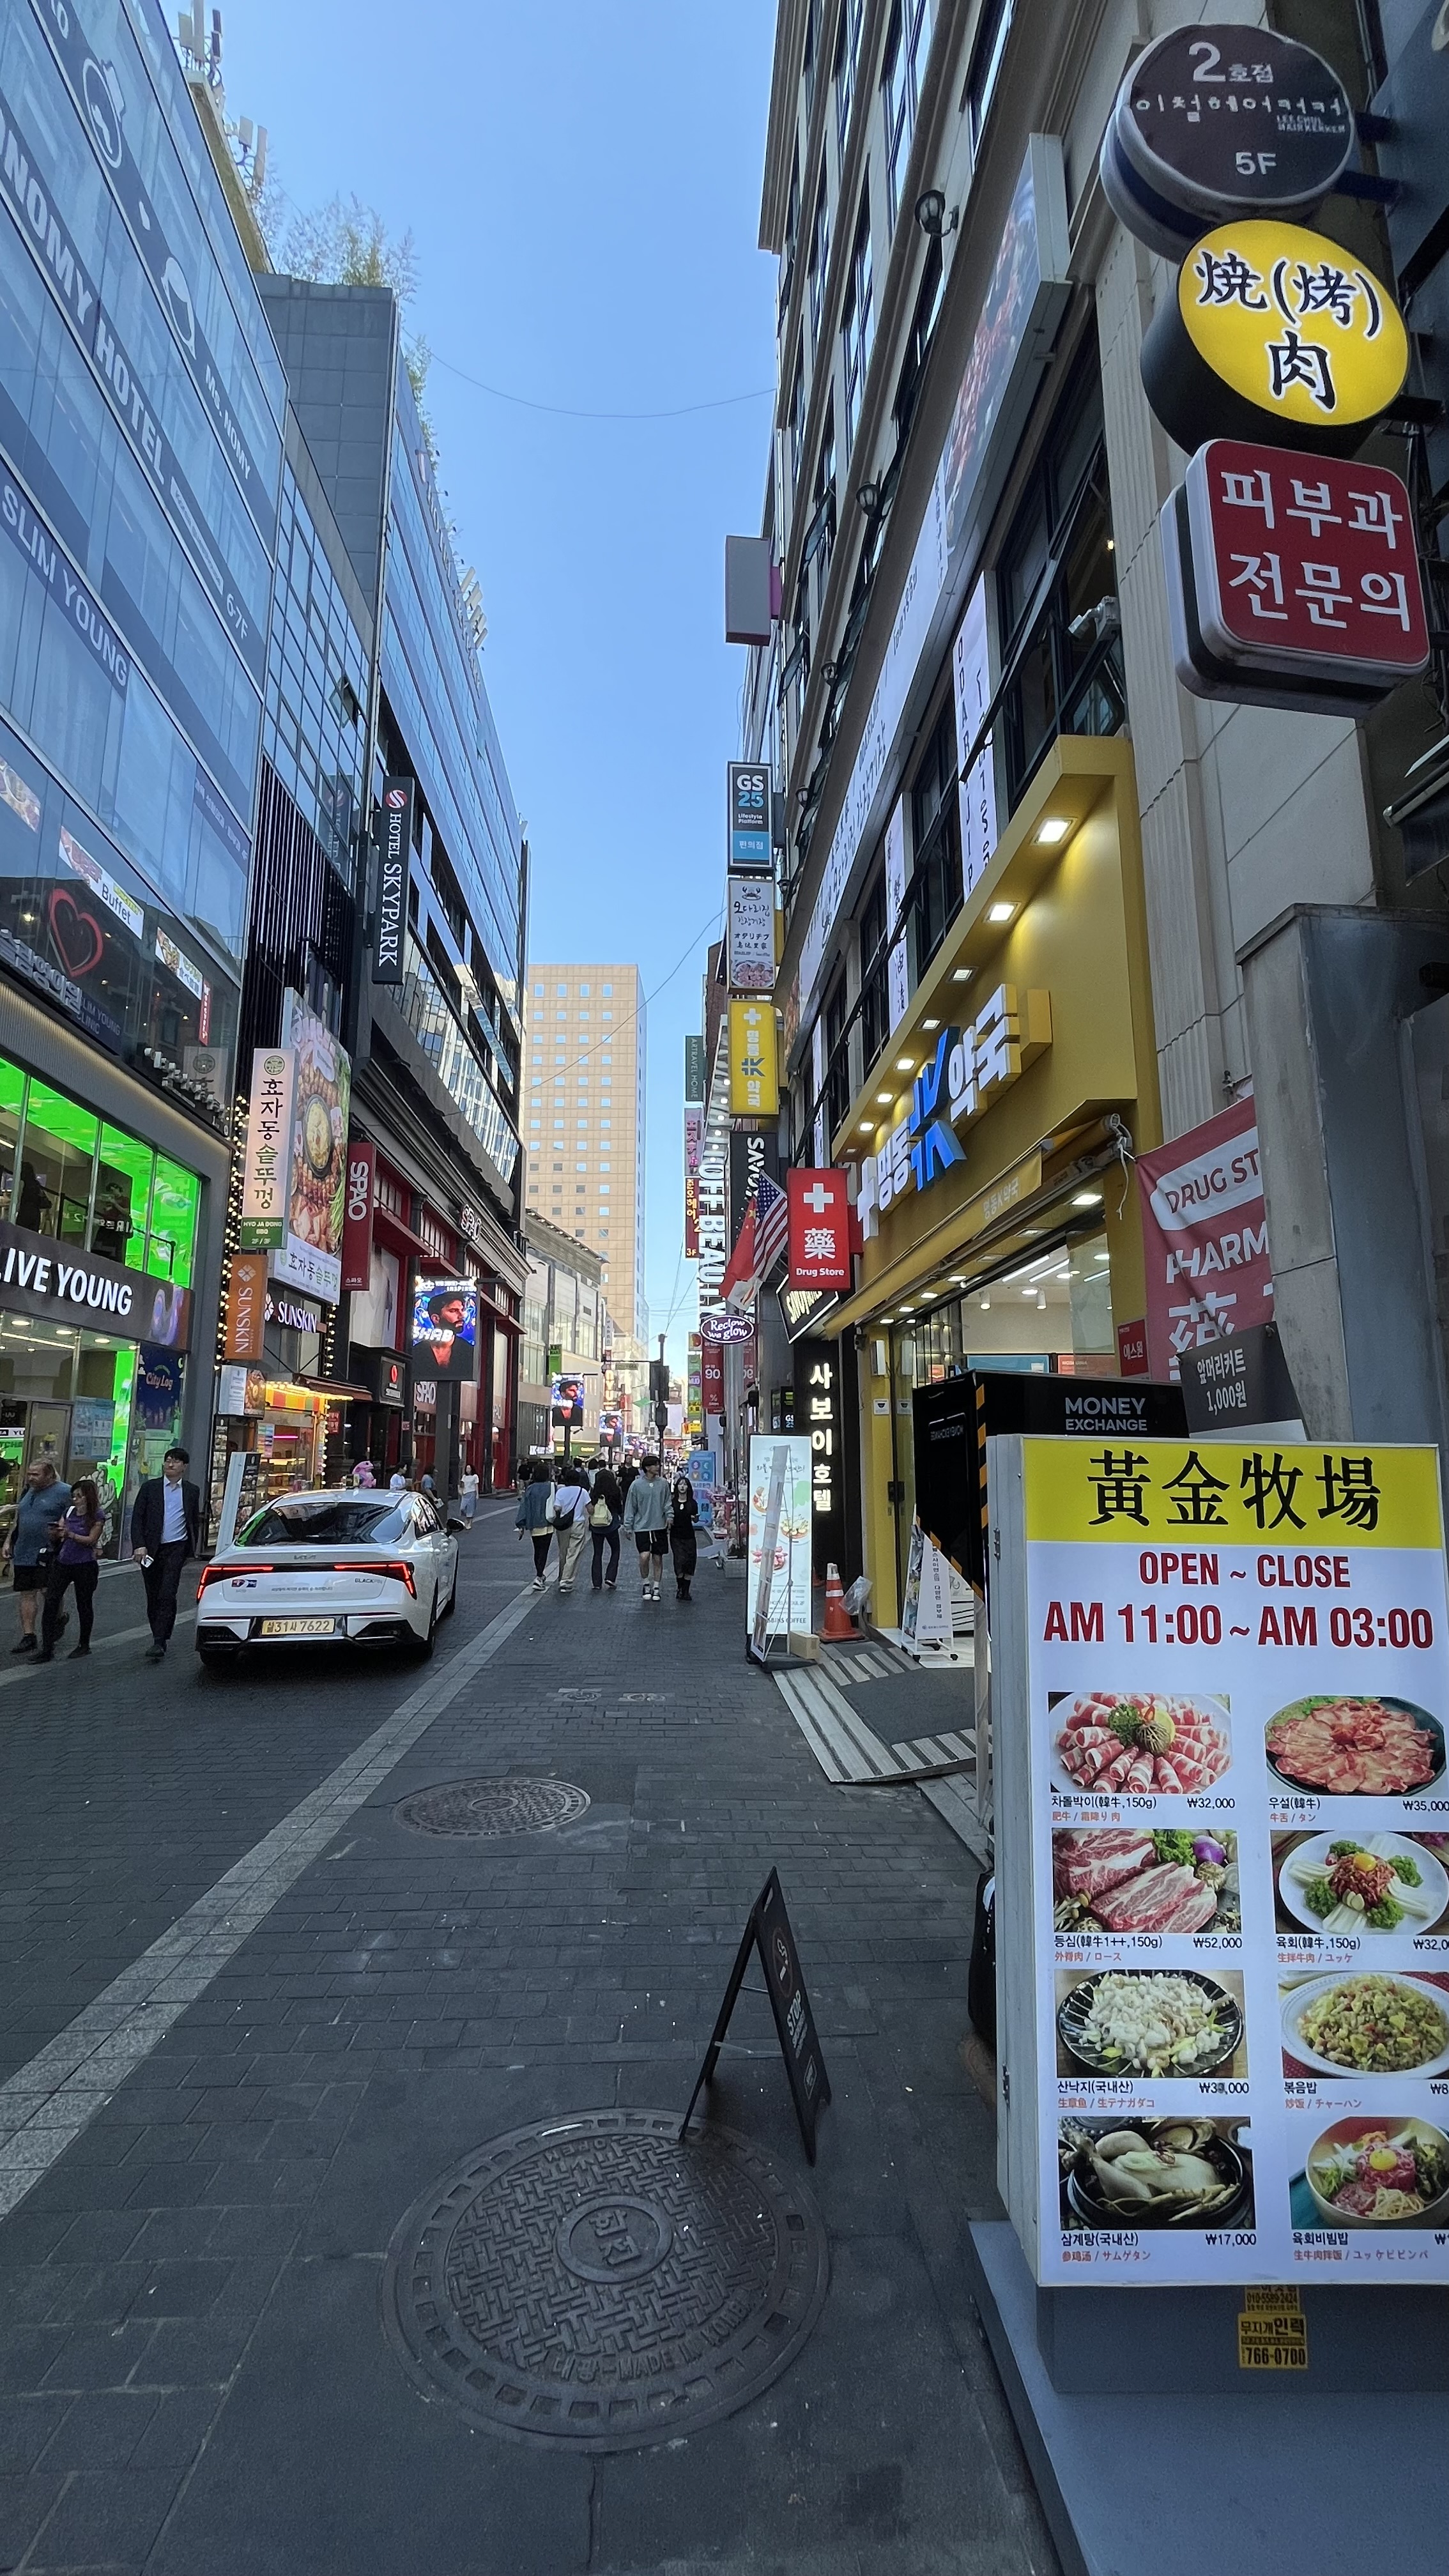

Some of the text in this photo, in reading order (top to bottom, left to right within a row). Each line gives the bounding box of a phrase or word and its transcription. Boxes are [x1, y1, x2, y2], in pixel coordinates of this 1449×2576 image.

[1236, 151, 1277, 175] 5F
[0, 106, 165, 484] NOMY HOTEL
[1267, 332, 1336, 411] 肉
[1220, 469, 1403, 550] 피부과
[2, 484, 128, 688] SLIM YOUNG
[1228, 551, 1411, 632] 전문의
[958, 635, 973, 893] ODARJIP
[737, 774, 765, 792] GS
[737, 791, 765, 808] 25
[739, 839, 763, 850] 편의점
[378, 812, 403, 967] HOTEL SKYPARK
[101, 882, 132, 926] Buffet
[690, 1038, 699, 1098] ARTRAVEL HOME
[348, 1161, 369, 1222] SPAO
[1165, 1167, 1227, 1215] DRUG
[803, 1227, 836, 1259] 藥
[0, 1246, 134, 1316] IVE YOUNG
[795, 1268, 845, 1277] Drug Store
[234, 1287, 253, 1354] SUNSKIN
[277, 1301, 318, 1334] SUNSKIN
[710, 1319, 746, 1331] Reclow
[707, 1326, 748, 1341] we glow
[1123, 1343, 1144, 1361] 에스원
[705, 1368, 721, 1380] 90
[1196, 1347, 1246, 1386] 앞머리커트
[416, 1381, 436, 1405] SPAO
[1206, 1380, 1248, 1416] 1,000원
[1064, 1397, 1146, 1415] MONEY
[809, 1361, 834, 1512] 사보이호텔
[1065, 1418, 1147, 1431] EXCHANGE
[1087, 1448, 1382, 1531] 黃金牧場
[1139, 1551, 1220, 1586] OPEN
[1256, 1554, 1351, 1589] CLOSE
[300, 1620, 330, 1632] 7622
[1043, 1601, 1434, 1650] AM 11:00 AM 03:00
[1051, 1796, 1236, 1811] 차돌박이(韓牛,150g) ₩32,000
[1268, 1796, 1321, 1811] 우설(韓牛)
[1298, 1813, 1317, 1822] タン
[1193, 1936, 1243, 1949] ₩52,000
[1276, 1936, 1449, 1951] 육회(韓牛,150g) ₩32,0
[1324, 1953, 1353, 1963] ユッケ
[786, 1989, 802, 2036] STOP
[1057, 2079, 1134, 2094] 산낙지(국내산)
[1284, 2081, 1317, 2095] 볶음밥
[1315, 2099, 1363, 2109] チャーハン
[588, 2209, 639, 2267] 한전
[1060, 2232, 1257, 2248] 삼계탕(국내산) ₩17,000
[1292, 2232, 1349, 2246] 육회비빔밥
[1245, 2347, 1306, 2366] 766-0700
